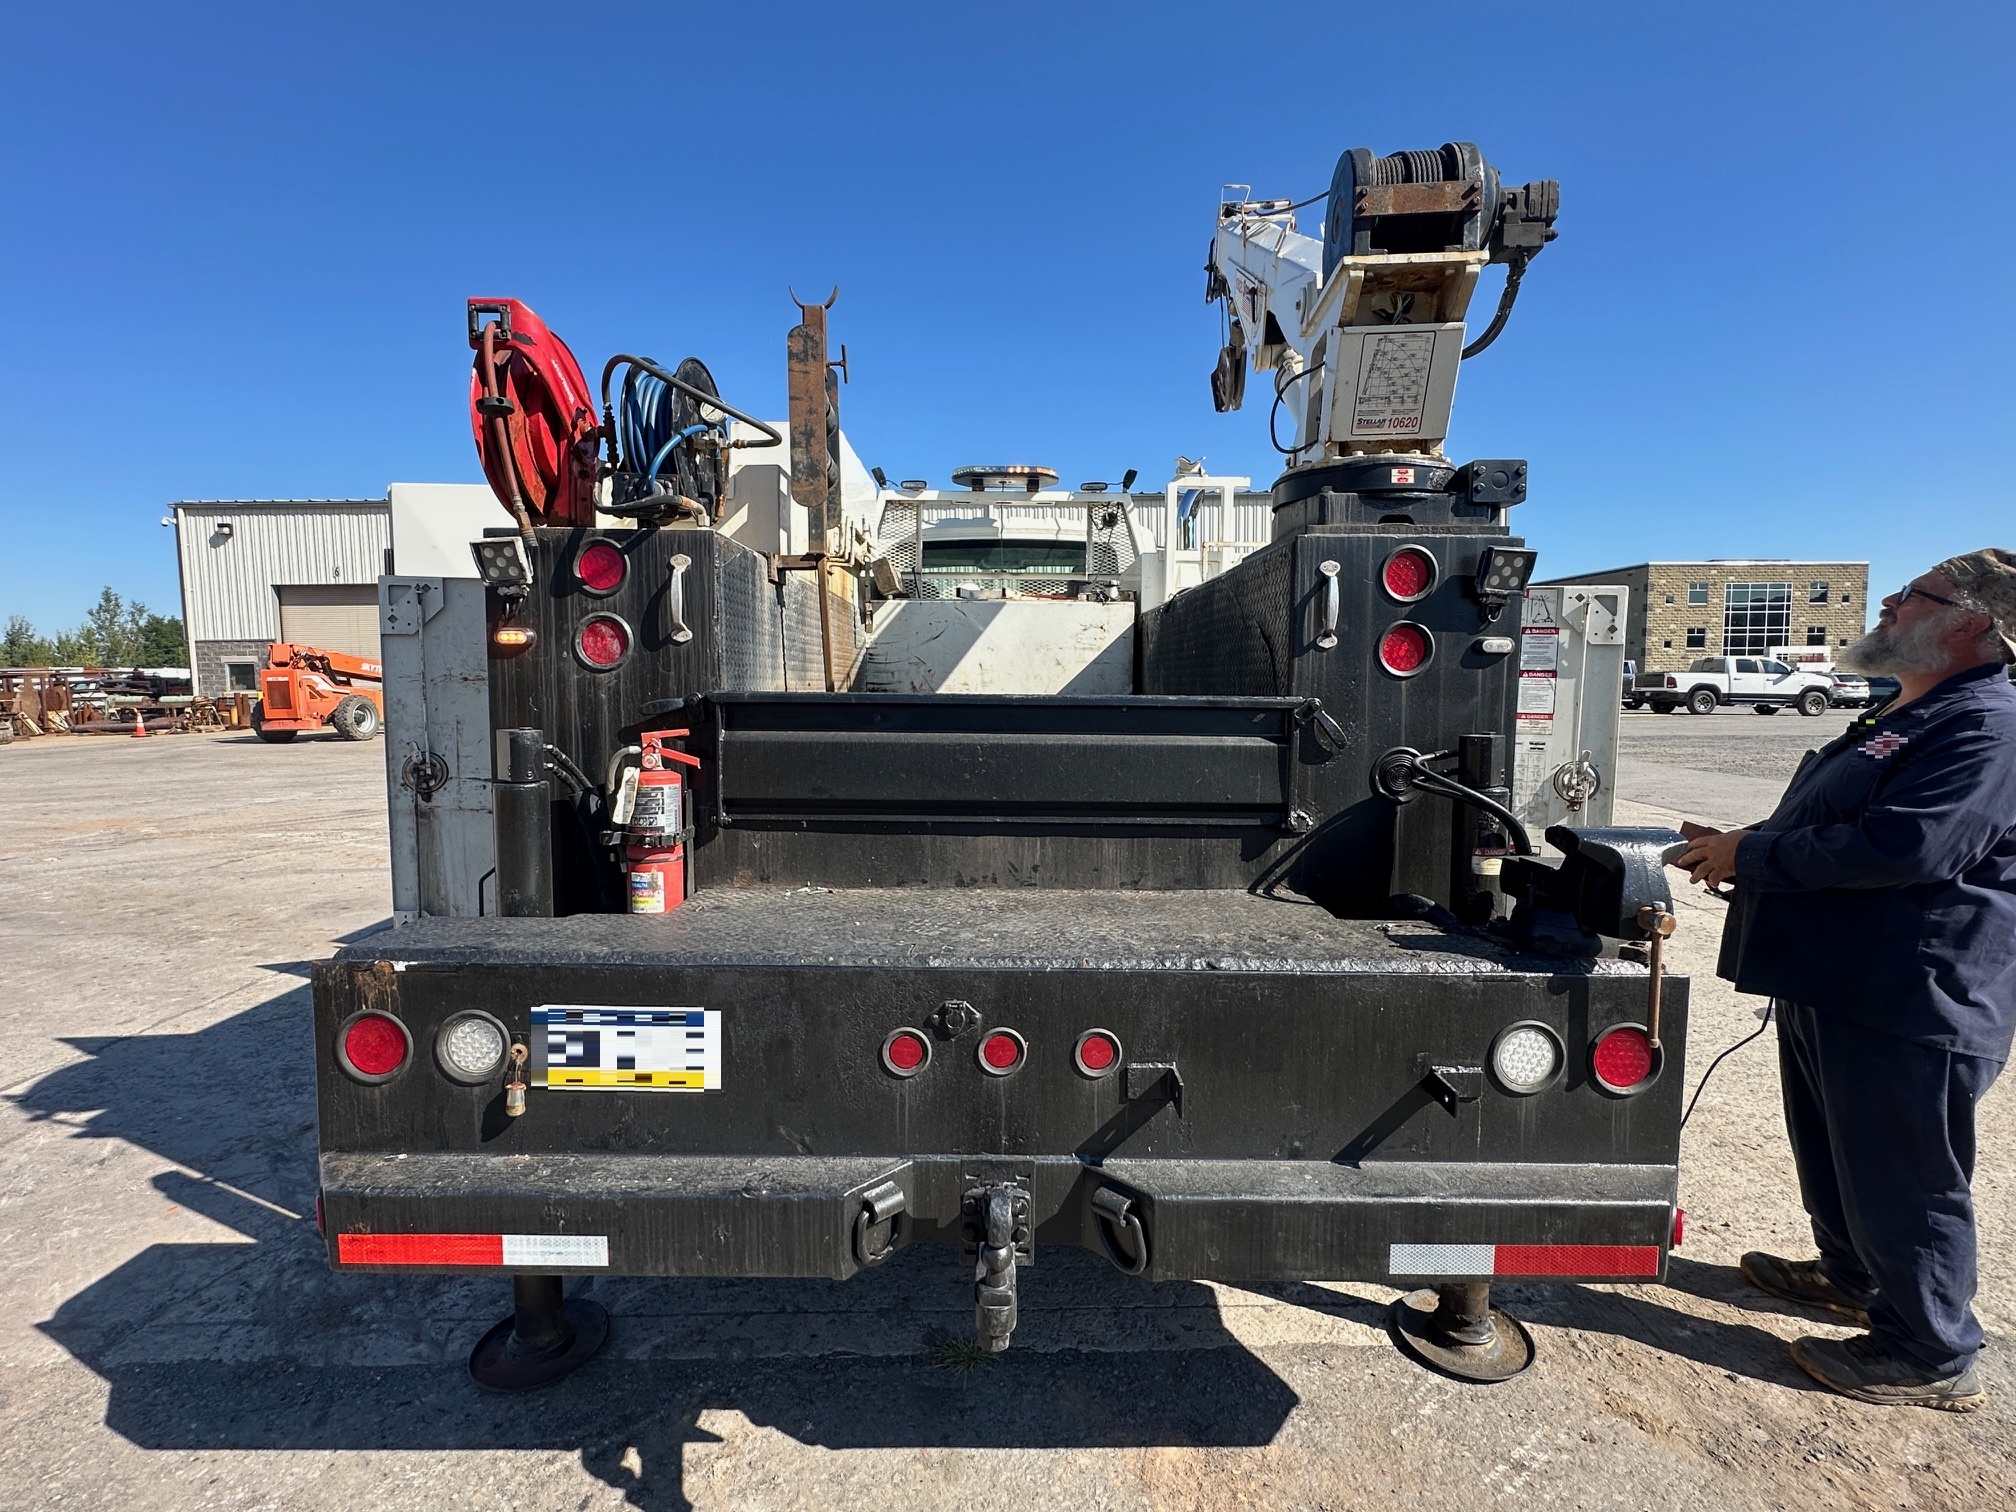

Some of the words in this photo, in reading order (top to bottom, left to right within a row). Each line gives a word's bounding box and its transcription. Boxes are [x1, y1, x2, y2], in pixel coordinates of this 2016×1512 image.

[1357, 417, 1387, 426] STELLAR
[1387, 416, 1418, 429] 10620
[334, 566, 340, 576] 6
[1484, 848, 1507, 856] DANGE
